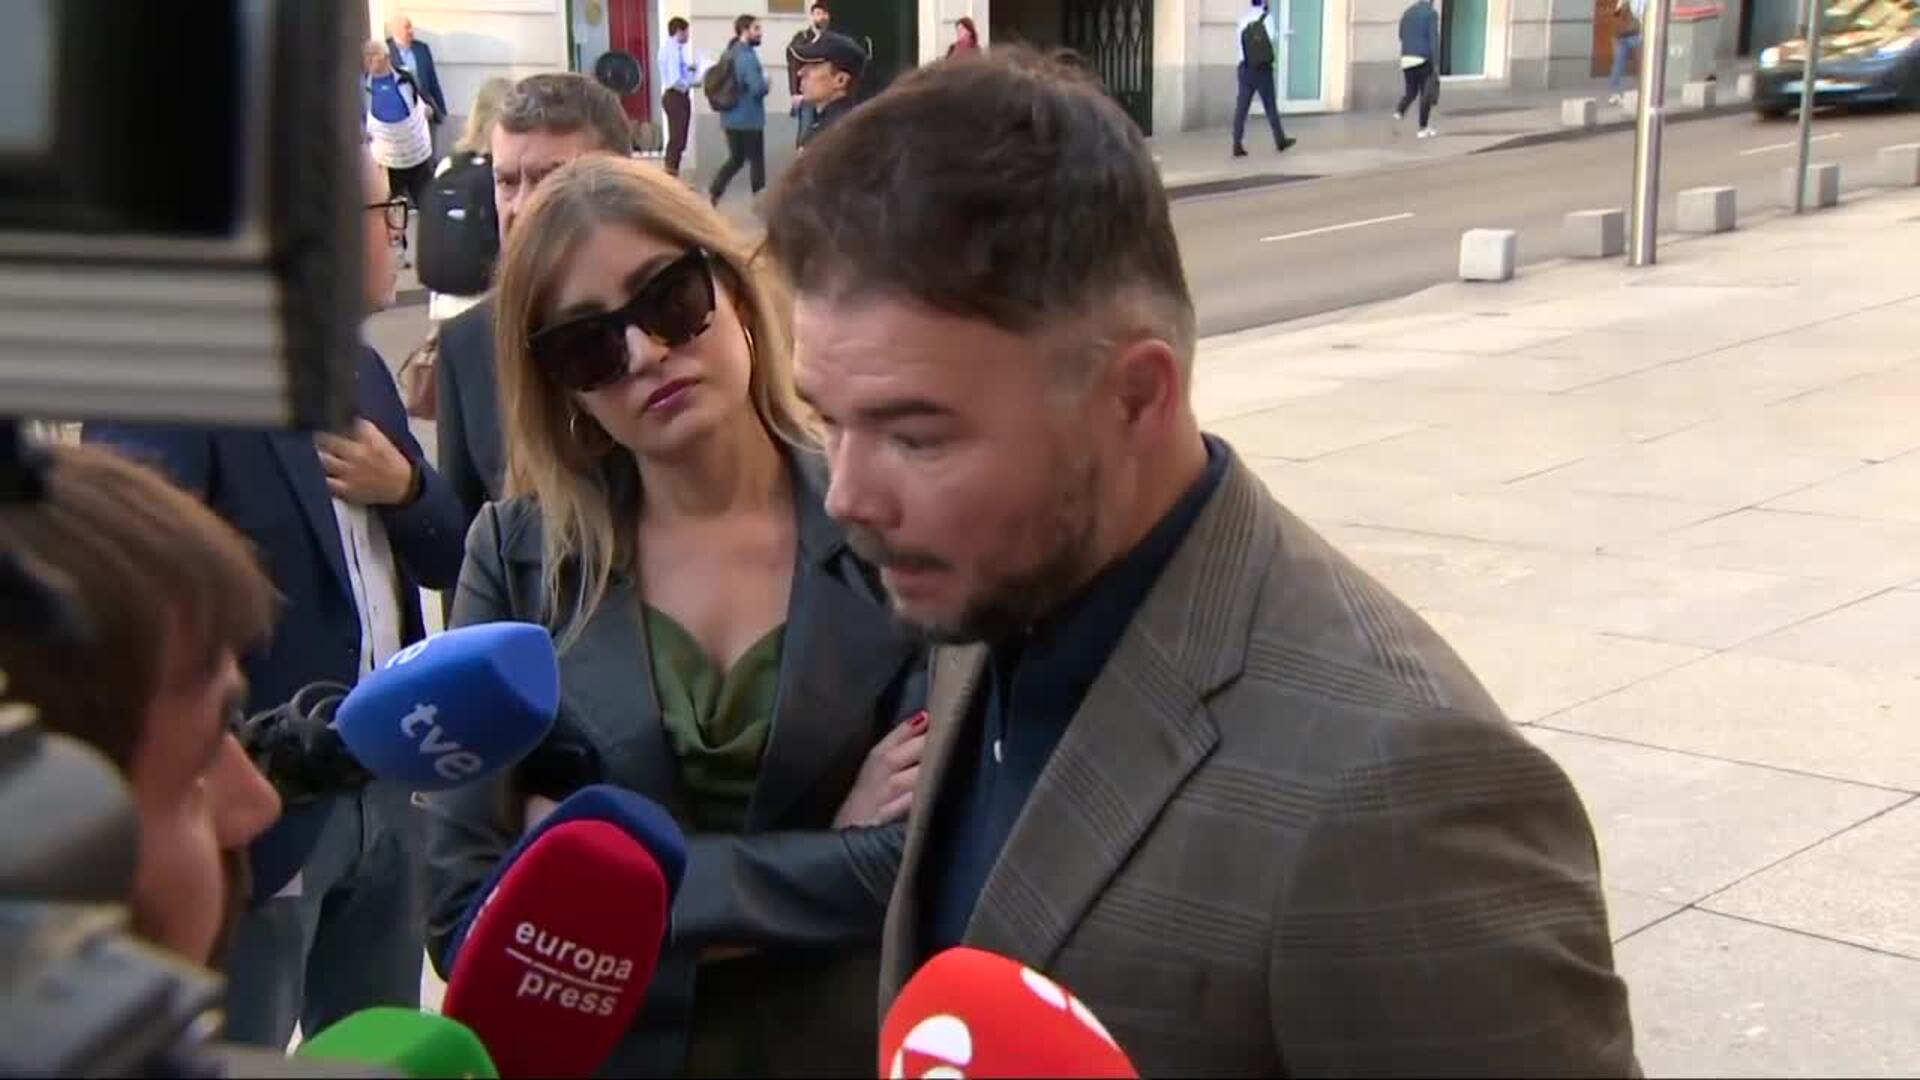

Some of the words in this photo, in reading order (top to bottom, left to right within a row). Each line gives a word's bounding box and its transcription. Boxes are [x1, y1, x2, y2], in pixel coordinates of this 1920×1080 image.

[399, 703, 482, 781] tve
[515, 921, 634, 981] europa
[516, 971, 618, 1016] press
